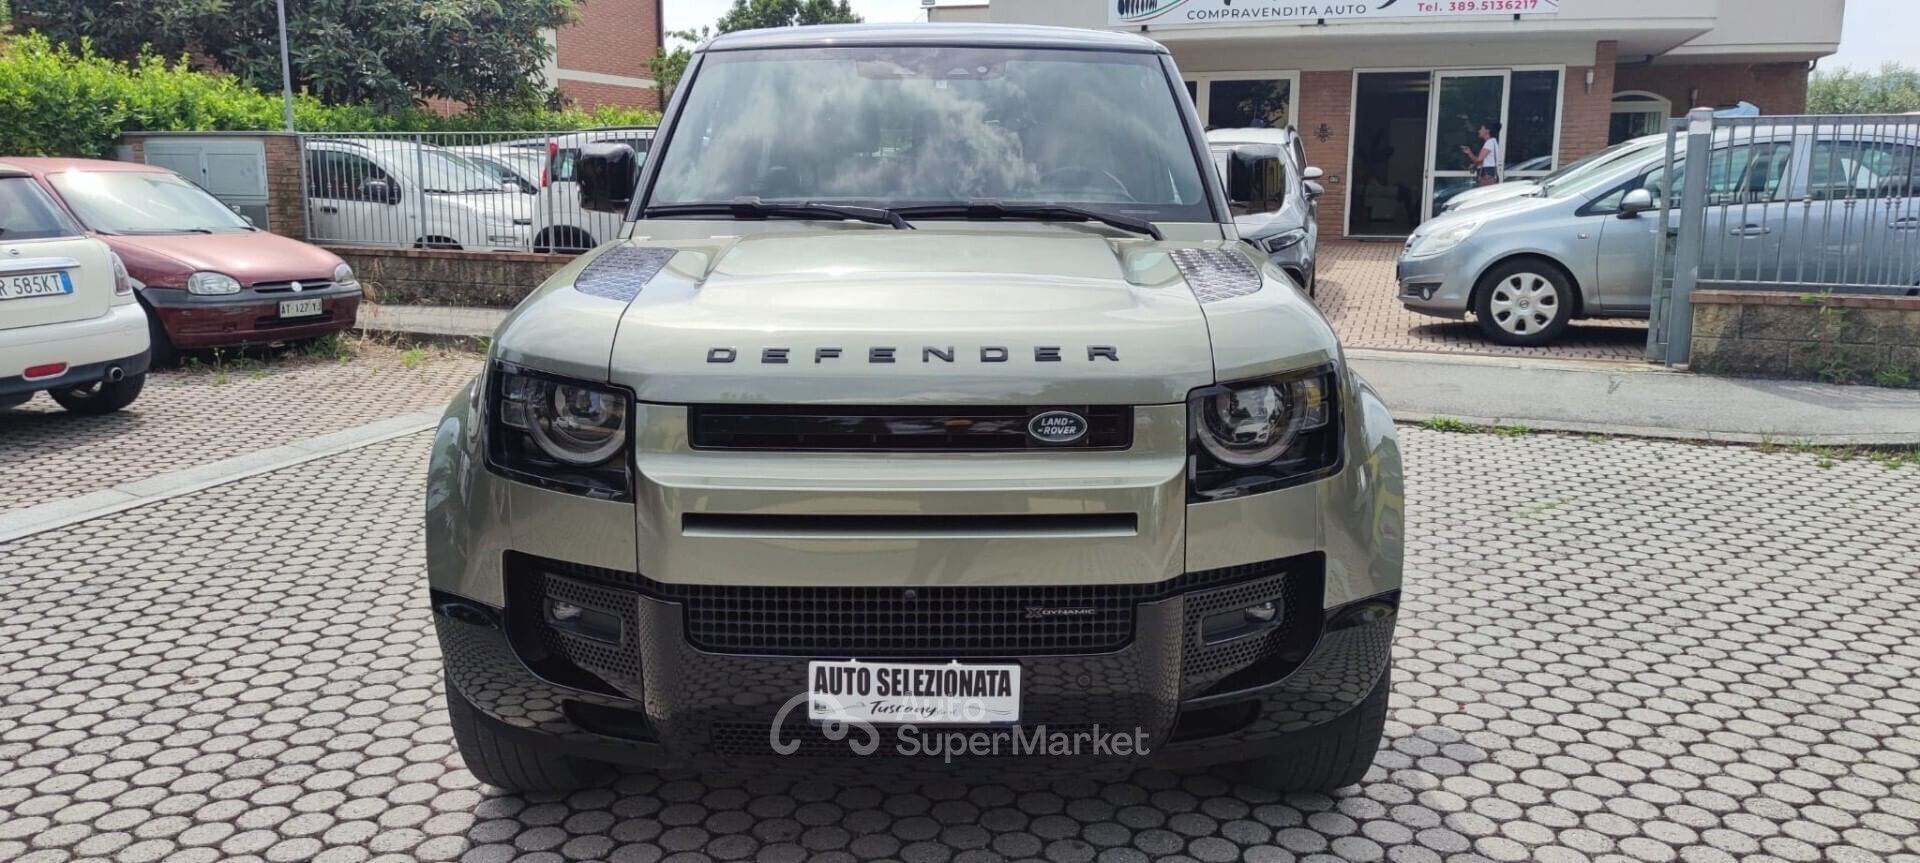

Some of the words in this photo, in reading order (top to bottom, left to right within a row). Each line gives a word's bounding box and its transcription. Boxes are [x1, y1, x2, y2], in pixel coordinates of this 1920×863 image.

[1187, 6, 1318, 21] COMPRAVENDITA
[1324, 3, 1367, 16] AUTO
[1417, 2, 1442, 12] Tel.
[1449, 0, 1538, 12] 389.5136217
[13, 274, 60, 295] 585KT
[706, 345, 1120, 364] DEFENDER
[814, 666, 871, 696] AUTO
[877, 667, 1012, 698] SELEZIONATA
